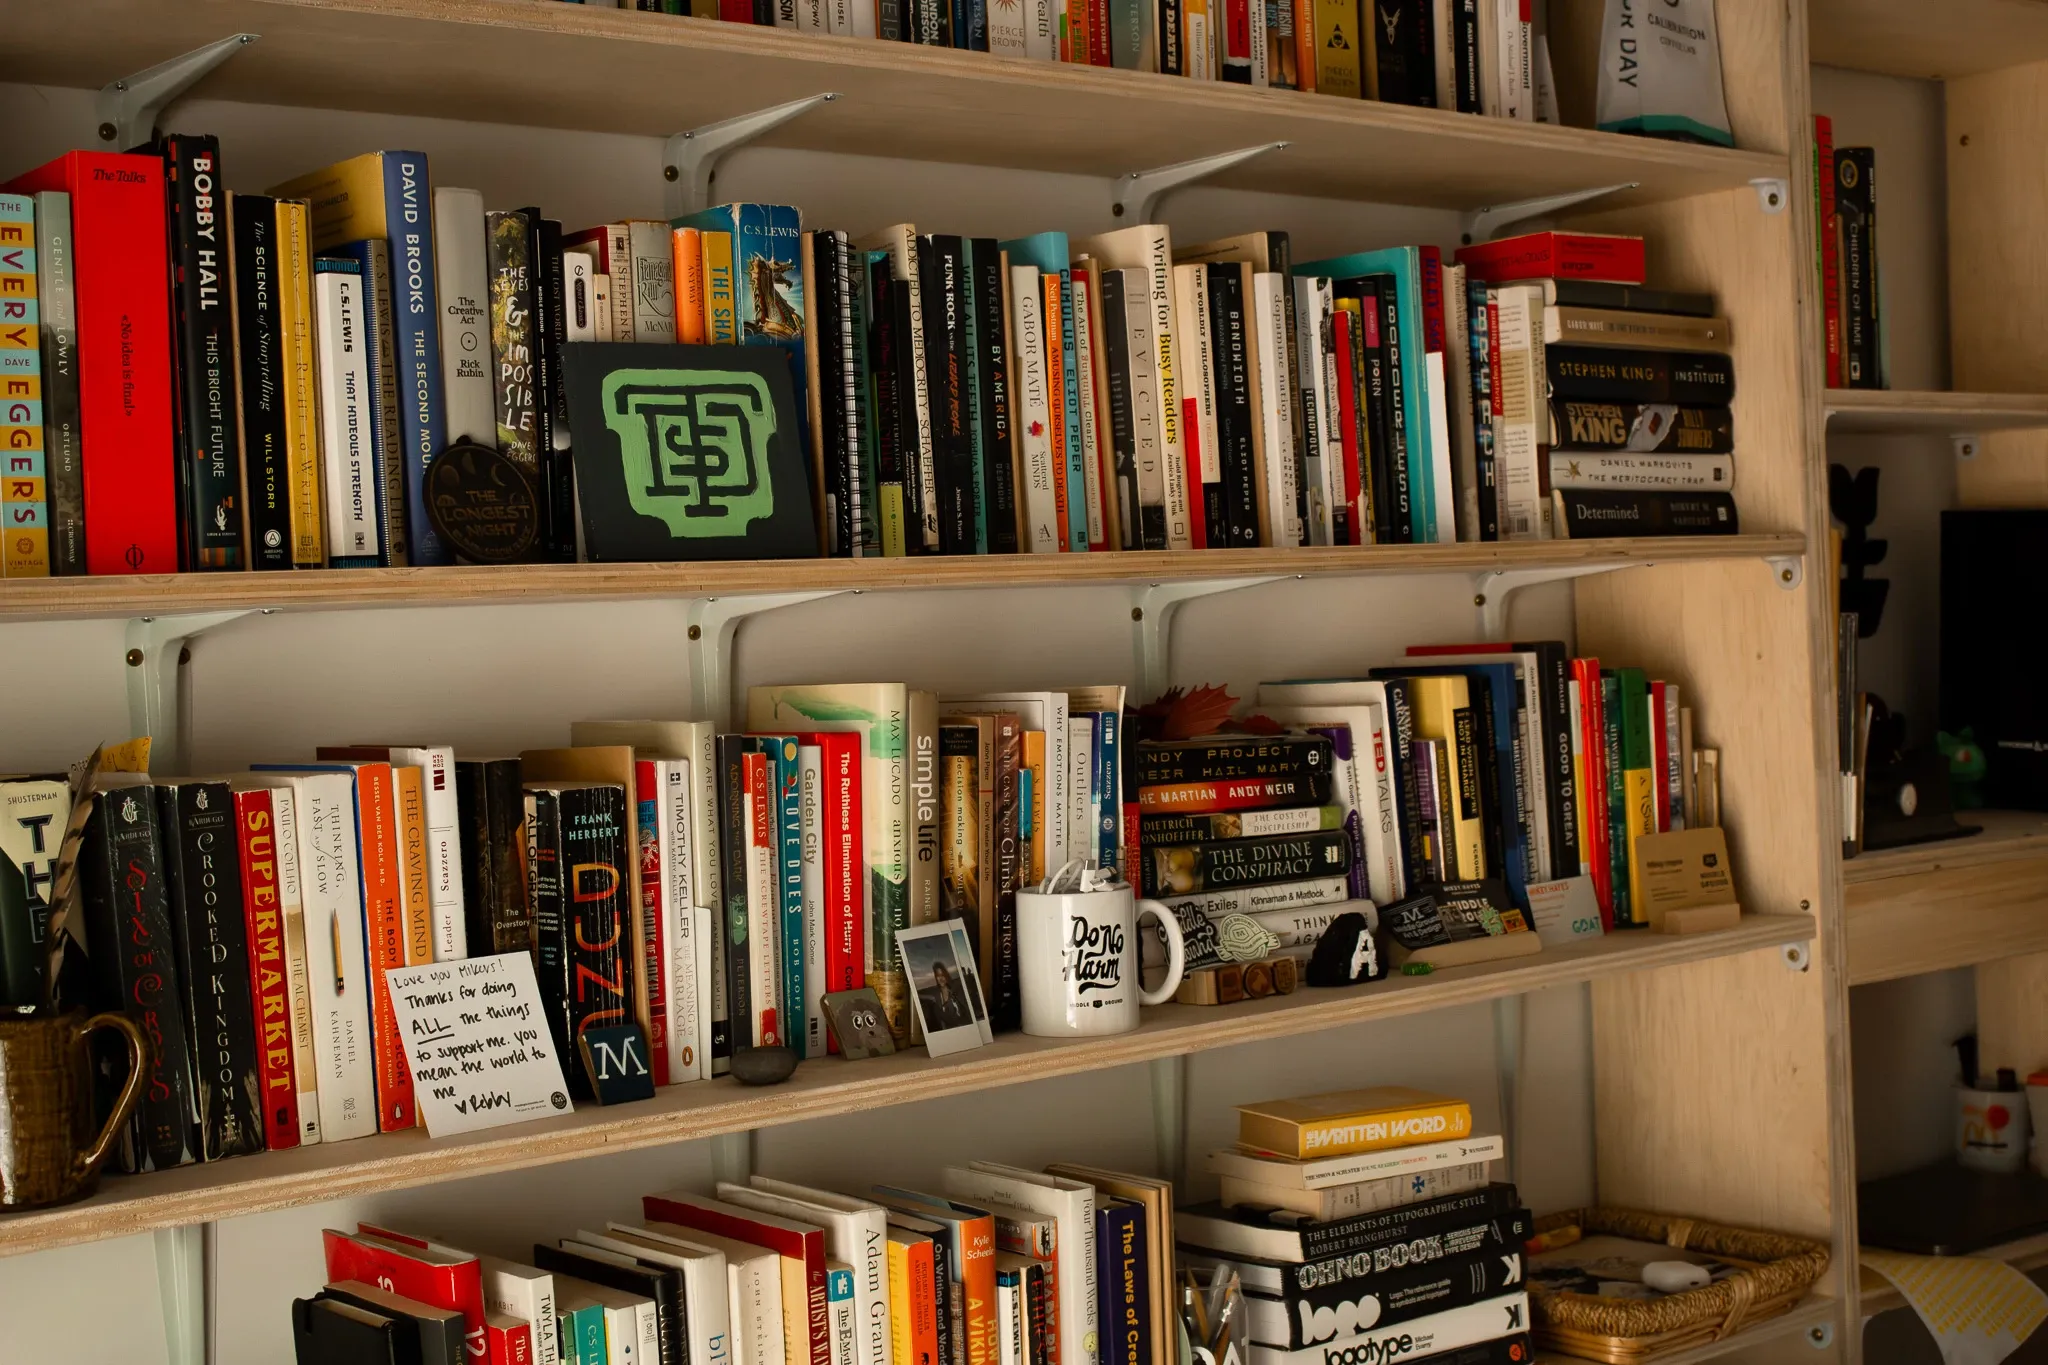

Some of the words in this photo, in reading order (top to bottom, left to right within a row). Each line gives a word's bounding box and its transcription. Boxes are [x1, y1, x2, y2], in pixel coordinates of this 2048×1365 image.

[992, 25, 1024, 37] PIERCE
[992, 37, 1025, 48] BROWN
[1648, 13, 1706, 41] CALIBRATION
[1618, 39, 1637, 88] DAY
[92, 168, 114, 183] The
[116, 168, 147, 184] Talks
[193, 157, 216, 242] BOBBY
[500, 266, 527, 278] THE
[906, 228, 920, 297] ADDICTED
[944, 254, 953, 290] PUNK
[1152, 237, 1167, 300] Writing
[1850, 222, 1860, 289] CHILDREN
[198, 250, 219, 311] HALL
[500, 279, 529, 291] EYES
[618, 267, 628, 326] STEPHEN
[448, 306, 484, 316] Creative
[458, 297, 475, 306] The
[911, 302, 921, 322] TO
[946, 293, 956, 330] ROCK
[1059, 268, 1074, 351] CUMULUS
[1157, 304, 1170, 329] for
[460, 316, 475, 325] Act
[1852, 316, 1861, 345] TIME
[5, 357, 31, 368] DAVE
[205, 334, 218, 365] THIS
[460, 359, 480, 368] Rick
[1158, 333, 1172, 373] Busy
[1229, 311, 1245, 405] BANDWIDTH
[345, 370, 355, 404] THAT
[456, 368, 484, 378] Rubin
[502, 363, 533, 385] POS
[913, 327, 929, 415] MEDIOCRITY
[1559, 362, 1616, 379] STEPHEN
[1622, 362, 1655, 381] KING
[1675, 371, 1726, 384] INSTITUTE
[207, 367, 222, 422] BRIGHT
[504, 383, 532, 407] SIB
[1133, 327, 1155, 473] EVICTED
[1161, 376, 1177, 445] Readers
[1387, 305, 1409, 513] BORDERLESS
[1476, 303, 1495, 488] BREACH
[1565, 403, 1623, 419] STEPHEN
[346, 405, 360, 457] HIDEOUS
[505, 410, 532, 431] LE
[1305, 390, 1319, 456] TECHNOPOLY
[1568, 417, 1627, 444] KING
[211, 424, 225, 478] FUTURE
[920, 419, 935, 495] SCHAEFFER
[1600, 459, 1636, 469] DANIEL
[1639, 459, 1693, 470] MARKOVITS
[1031, 454, 1041, 489] MINDS
[1040, 450, 1050, 491] Scattered
[1588, 473, 1607, 482] THE
[1610, 474, 1678, 485] MERITOCRACY
[348, 459, 363, 522] STRENGTH
[1576, 504, 1640, 521] Determined
[9, 558, 44, 568] VINTAGE
[891, 710, 900, 742] MAX
[1202, 766, 1247, 777] HAIL
[1257, 761, 1300, 773] MARY
[1208, 746, 1293, 760] PROJECT
[1373, 728, 1386, 773] TED
[891, 748, 901, 806] LUCADO
[911, 735, 936, 821] simple
[956, 756, 964, 802] decision
[1076, 752, 1087, 821] Outliers
[1104, 761, 1112, 800] Scazzero
[1161, 782, 1217, 803] MARTIAN
[1229, 785, 1261, 798] ANDY
[1265, 783, 1296, 795] WEIR
[7, 792, 58, 805] SHUSTERMAN
[406, 786, 418, 823] THE
[804, 768, 817, 827] Garden
[1376, 775, 1393, 834] TALKS
[280, 799, 292, 840] PAULO
[569, 827, 620, 841] HERBERT
[574, 814, 613, 825] FRANK
[675, 793, 686, 868] TIMOTHY
[785, 792, 801, 845] LOVE
[956, 806, 965, 845] making
[1143, 818, 1194, 832] DIETRICH
[1253, 820, 1309, 833] DISCIPLESHIP
[804, 832, 817, 865] City
[892, 819, 902, 880] anxious
[918, 824, 937, 862] life
[1209, 847, 1245, 866] THE
[1253, 842, 1312, 858] DIVINE
[282, 842, 297, 895] COELHO
[408, 827, 423, 904] CRAVING
[441, 841, 449, 892] Scazzero
[1210, 858, 1313, 882] CONSPIRACY
[678, 873, 690, 939] KELLER
[787, 860, 802, 915] DOES
[924, 879, 932, 917] RAINER
[1207, 899, 1238, 912] Exiles
[496, 916, 530, 929] Overstory
[506, 908, 519, 917] The
[247, 810, 292, 1092] SUPERMARKET
[413, 909, 427, 957] MIND
[1350, 930, 1379, 979] A
[405, 991, 453, 1009] Thanks
[459, 985, 476, 999] for
[482, 982, 517, 998] doing
[211, 974, 234, 1101] KINGDOM
[412, 1018, 451, 1036] ALL
[460, 1012, 482, 1025] the
[486, 1002, 530, 1020] things
[331, 1010, 343, 1079] KAHNEMAN
[345, 1020, 356, 1065] DANIEL
[594, 1036, 648, 1079] M
[416, 1066, 458, 1081] mean
[461, 1061, 485, 1074] the
[490, 1049, 528, 1069] world
[532, 1046, 546, 1060] to
[433, 1085, 456, 1099] me
[1306, 1130, 1316, 1149] THE
[1314, 1122, 1391, 1147] WRITTEN
[1391, 1115, 1446, 1136] WORD
[1307, 1232, 1326, 1242] THE
[1329, 1219, 1377, 1238] ELEMENTS
[1379, 1216, 1392, 1226] OF
[1394, 1204, 1457, 1224] TYPOGRAPHIC
[1459, 1195, 1486, 1209] STYLE
[966, 1248, 995, 1260] Scheele
[973, 1236, 990, 1246] Kyle
[1084, 1227, 1096, 1286] Thousand
[1310, 1242, 1346, 1255] ROBERT
[1349, 1225, 1408, 1247] BRINGHURST
[866, 1228, 883, 1292] Adam
[1299, 1251, 1372, 1290] OHNO
[1374, 1234, 1444, 1273] BOOK
[541, 1294, 555, 1341] TWYLA
[839, 1308, 850, 1327] The
[1086, 1288, 1096, 1326] Weeks
[465, 1325, 486, 1357] 12
[515, 1335, 526, 1362] The
[869, 1301, 886, 1365] Grant
[988, 1320, 998, 1359] HOW
[1324, 1333, 1413, 1365] logotype
